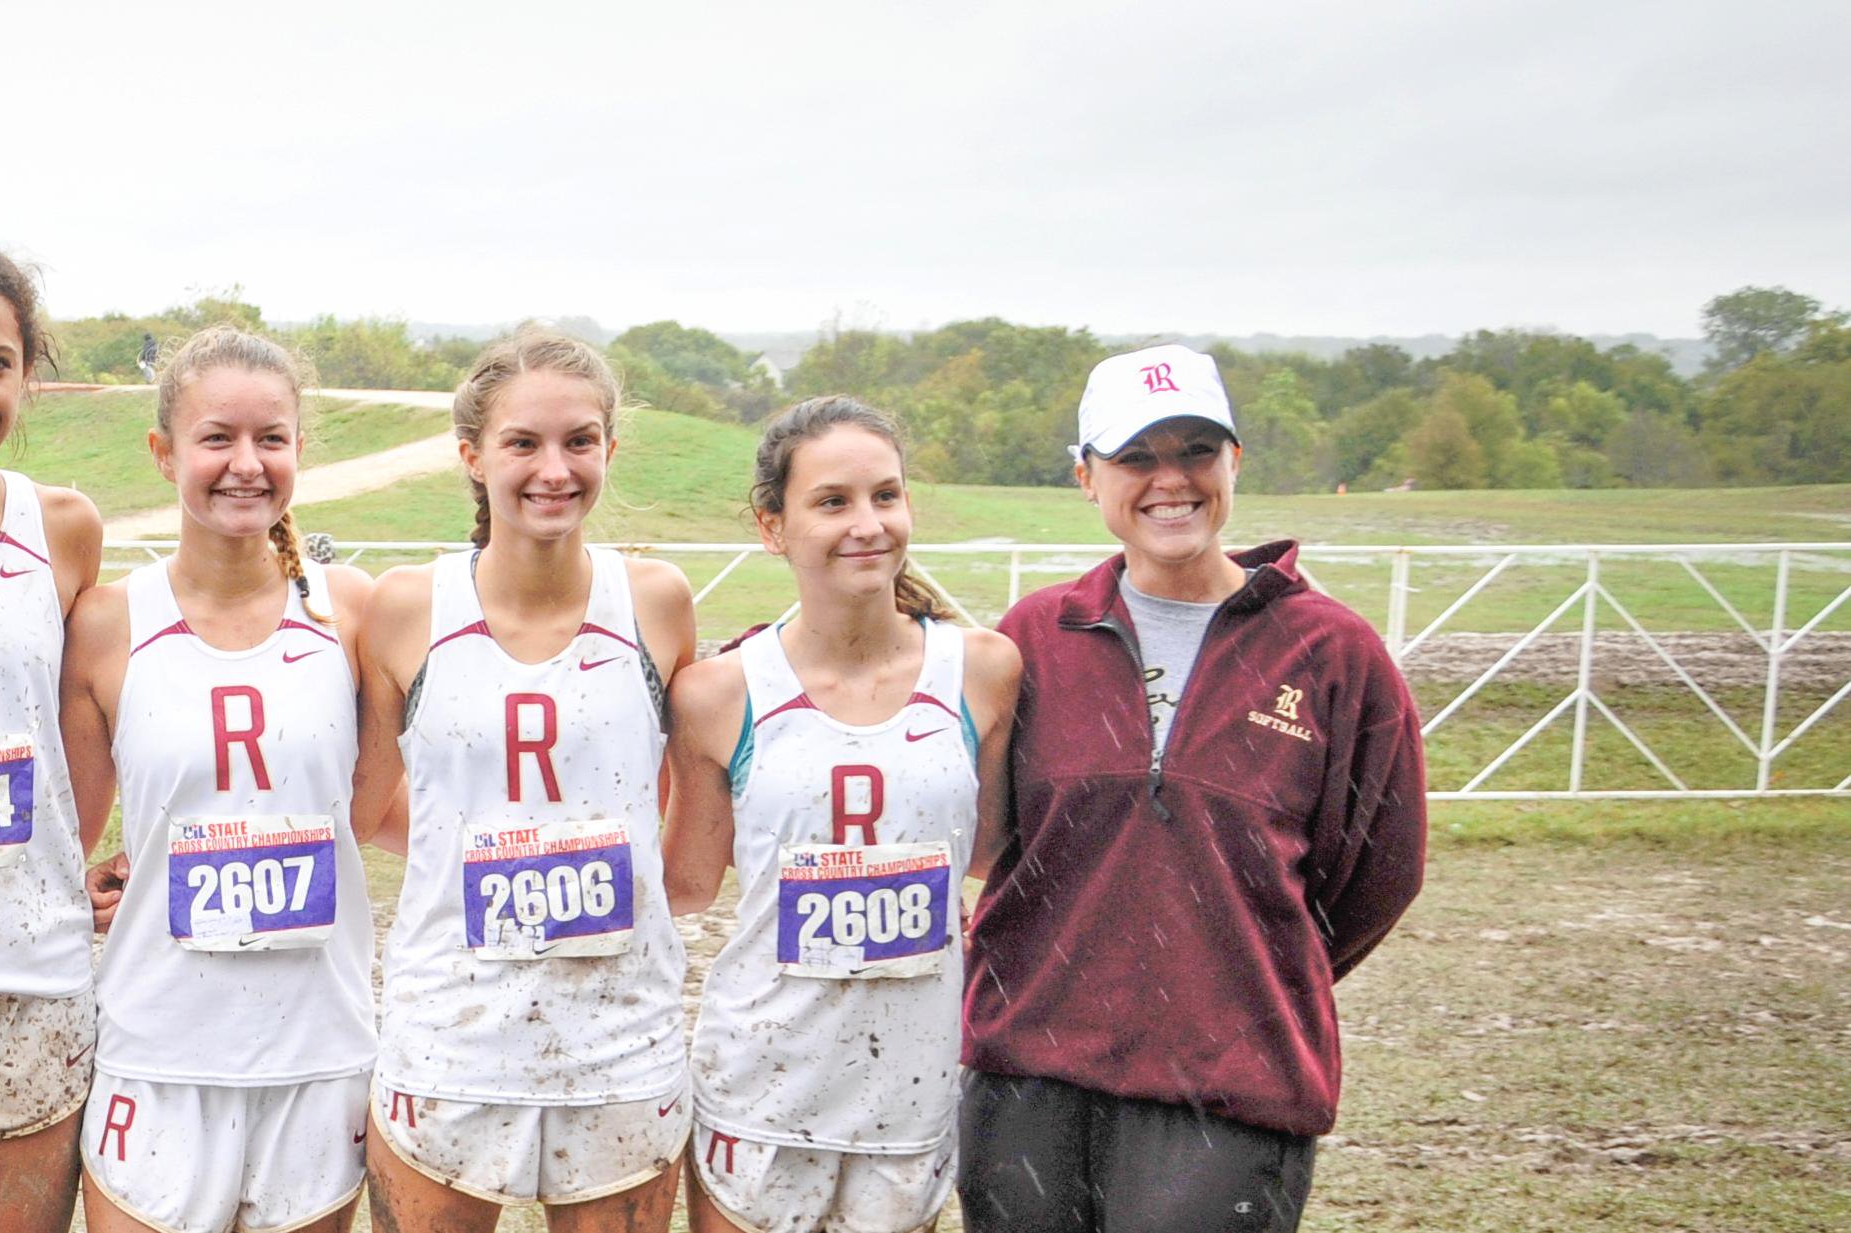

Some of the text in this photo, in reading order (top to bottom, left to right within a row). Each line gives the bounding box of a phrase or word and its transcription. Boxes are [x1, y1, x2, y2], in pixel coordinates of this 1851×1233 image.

[1140, 362, 1180, 395] R
[1274, 684, 1303, 720] R
[211, 685, 272, 792] R
[1247, 710, 1313, 741] SOFTBALL
[505, 692, 561, 803] R
[831, 764, 885, 845] R
[171, 827, 332, 854] CROSS COUNTRY CHAMPIONSHIPS
[208, 821, 247, 837] STATE
[498, 828, 539, 846] STATE
[465, 831, 627, 862] CROSS COUNTRY CHAMPIONSHIPS
[821, 852, 862, 866] STATE
[188, 855, 315, 919] 2607
[782, 867, 814, 880] CROSS
[817, 866, 863, 880] COUNTRY
[480, 861, 615, 927] 2606
[797, 883, 931, 947] 2608
[98, 1094, 136, 1162] R
